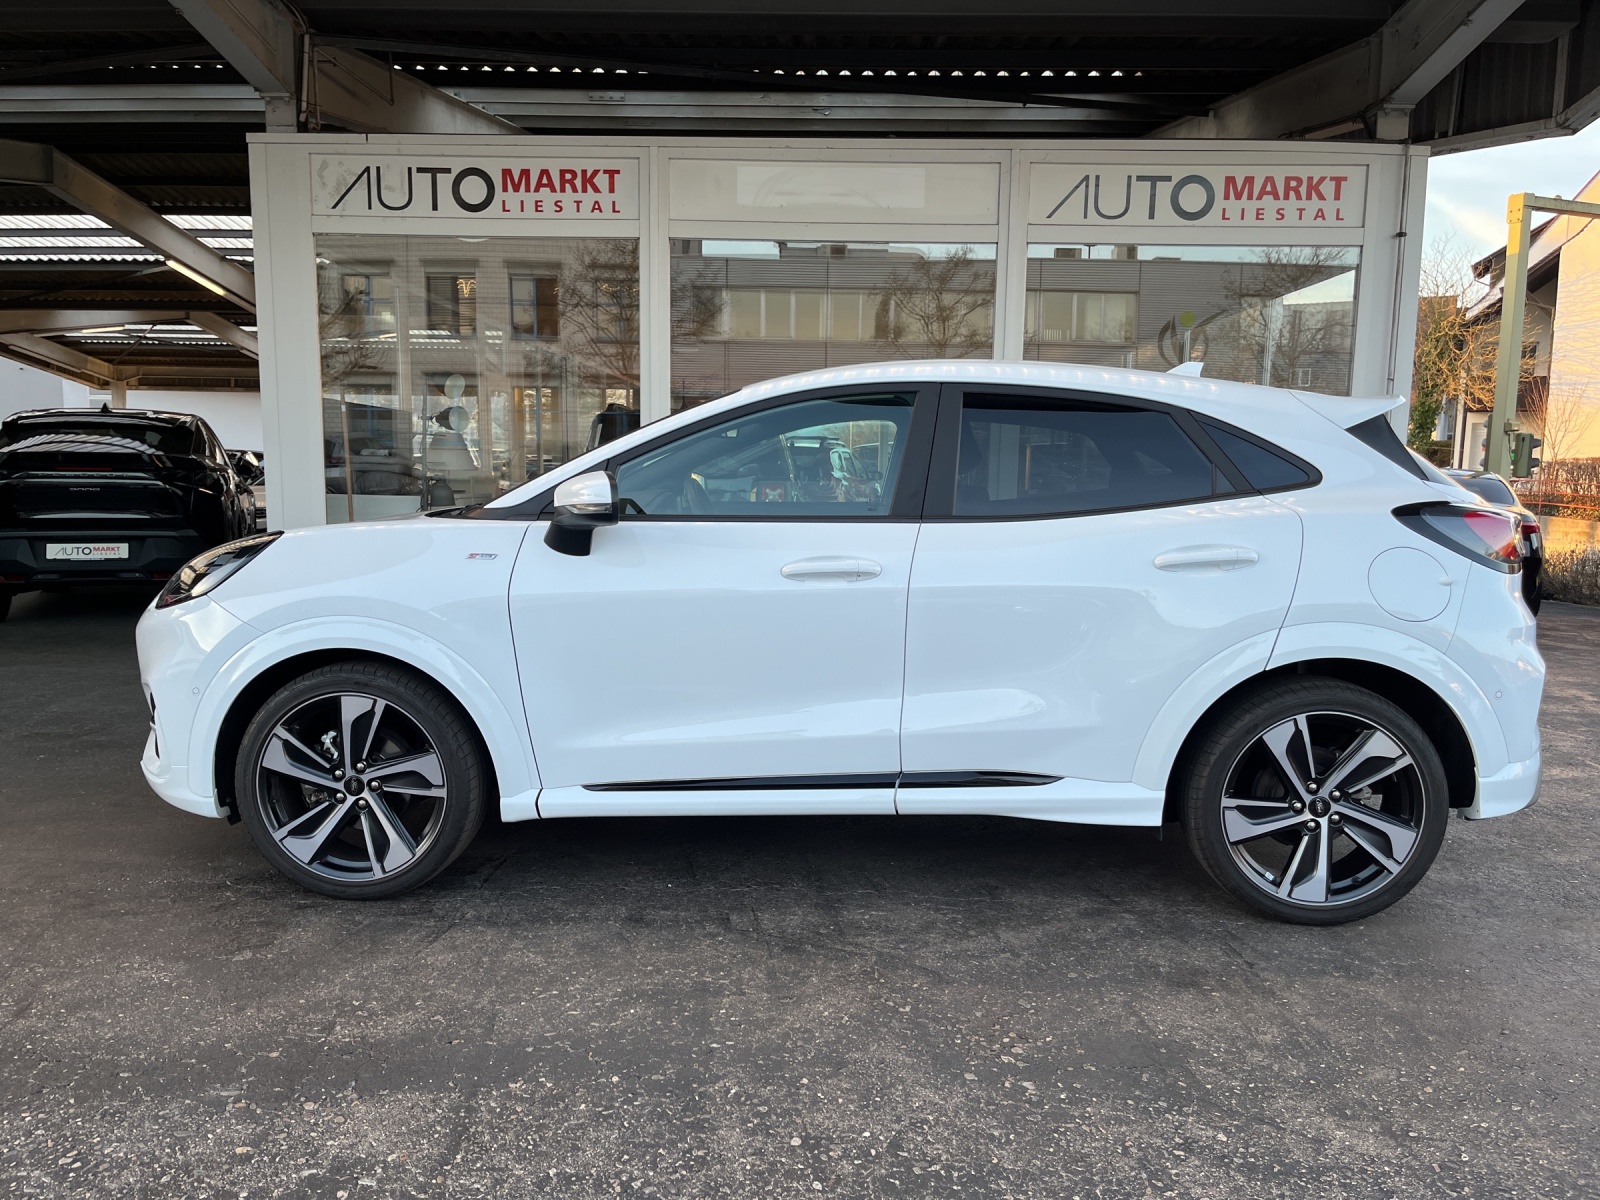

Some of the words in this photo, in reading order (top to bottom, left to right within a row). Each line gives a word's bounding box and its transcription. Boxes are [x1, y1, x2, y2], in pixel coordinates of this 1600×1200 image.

[331, 166, 495, 212] AUTO
[501, 168, 621, 194] MARKT
[1046, 174, 1215, 221] AUTO
[1223, 175, 1348, 201] MARKT
[502, 200, 621, 213] LIESTAL
[1221, 207, 1345, 221] LIESTAL
[55, 547, 92, 556] AUTO
